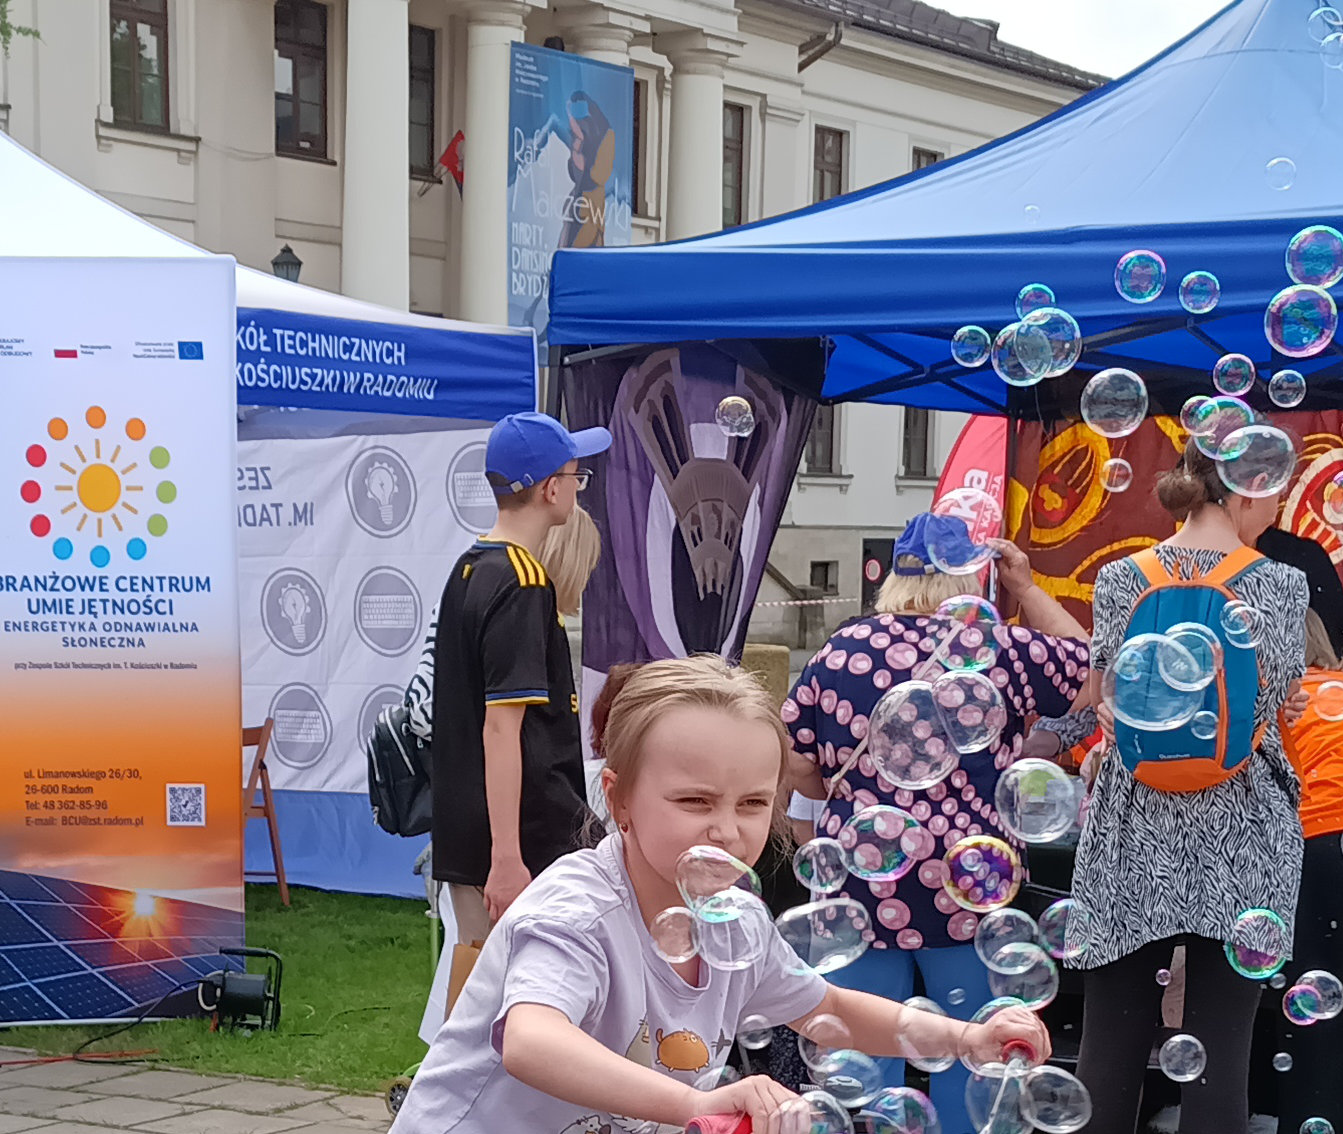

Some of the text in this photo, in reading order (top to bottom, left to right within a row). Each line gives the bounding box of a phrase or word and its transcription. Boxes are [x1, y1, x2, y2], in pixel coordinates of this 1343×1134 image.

[273, 328, 406, 366] TECHNICZNYCH
[343, 370, 359, 394] W
[361, 373, 438, 400] RADOMIU
[115, 575, 211, 593] CENTRUM
[4, 620, 199, 633] ENERGETYKA ODNAWIALNA
[62, 636, 146, 648] SŁONECZNA
[24, 768, 142, 781] ul. Limanowskiego 26/30,
[25, 784, 93, 795] 26-600 Radom
